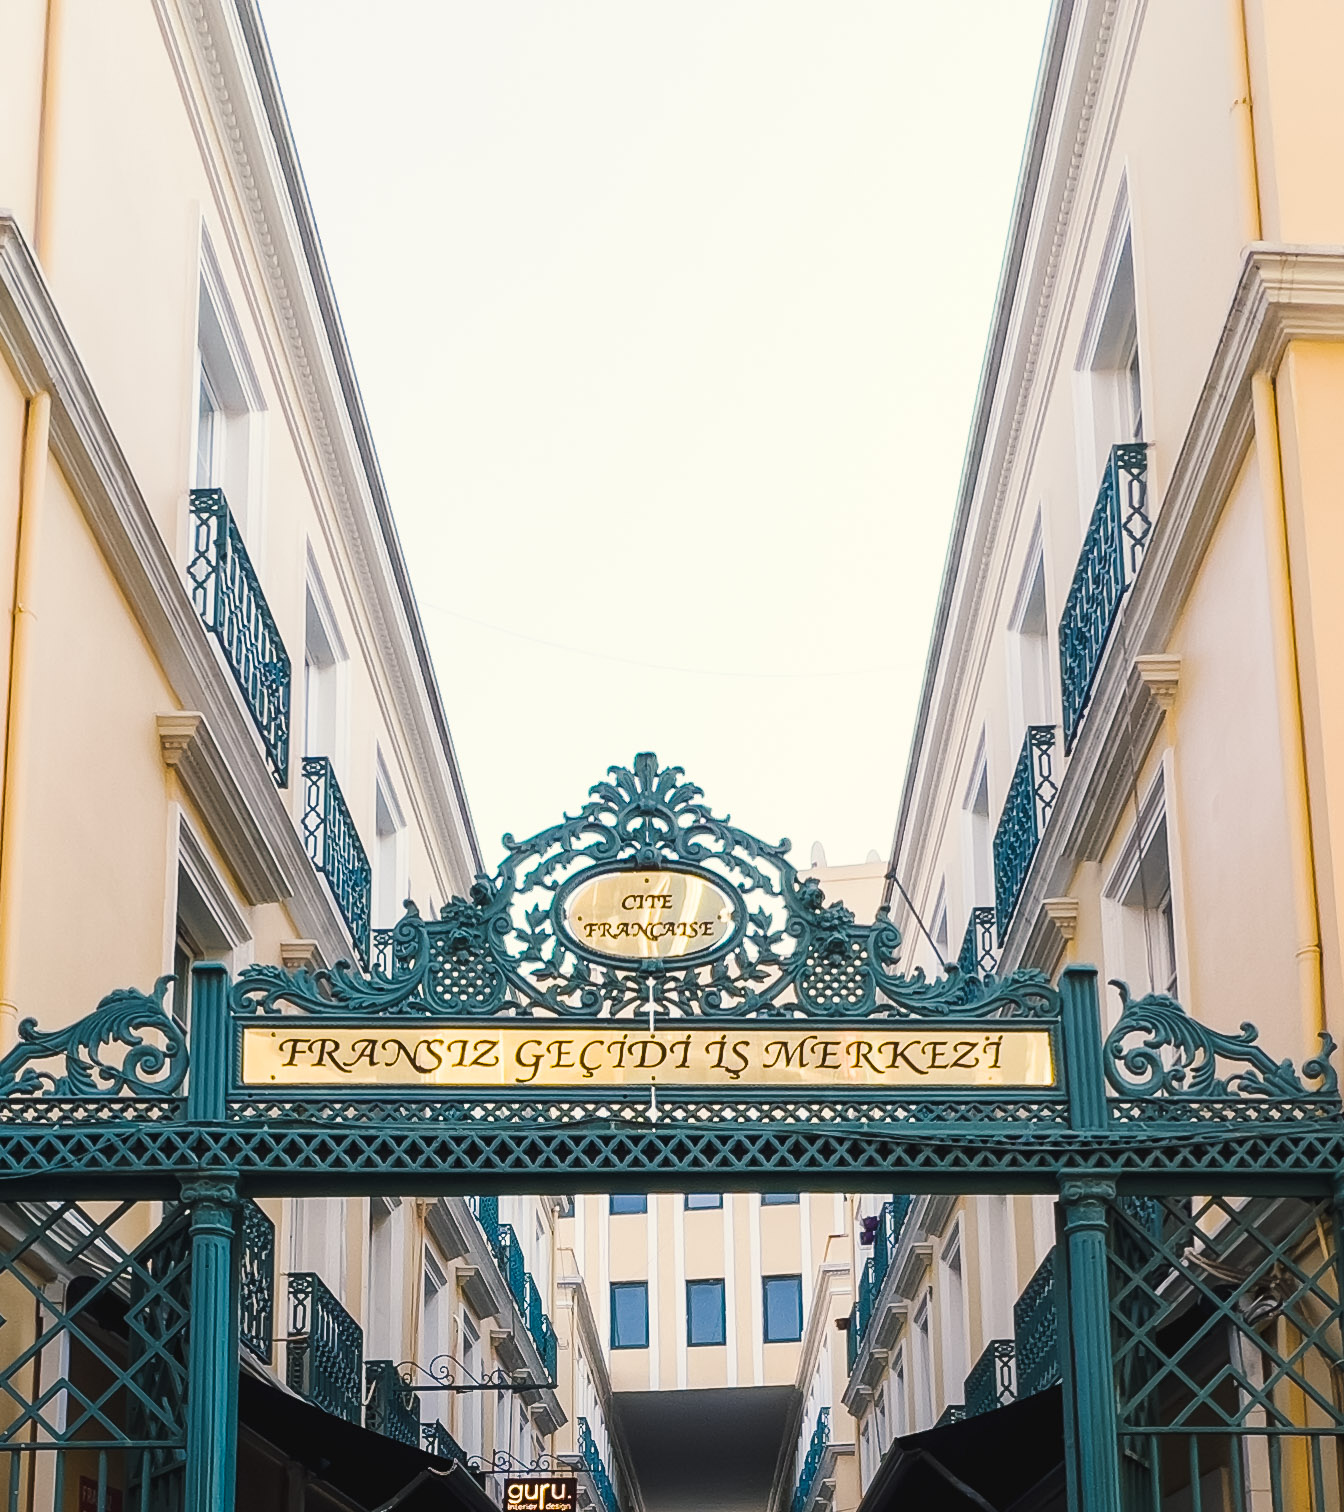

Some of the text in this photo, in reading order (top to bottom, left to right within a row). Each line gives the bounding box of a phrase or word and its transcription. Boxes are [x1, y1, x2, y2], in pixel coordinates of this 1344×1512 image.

[622, 894, 673, 910] CITE
[584, 921, 714, 941] FRANÇAISE
[278, 1033, 1004, 1083] FRANSIZ GEÇİDİ İŞ MERKEZİ
[545, 1503, 572, 1511] design
